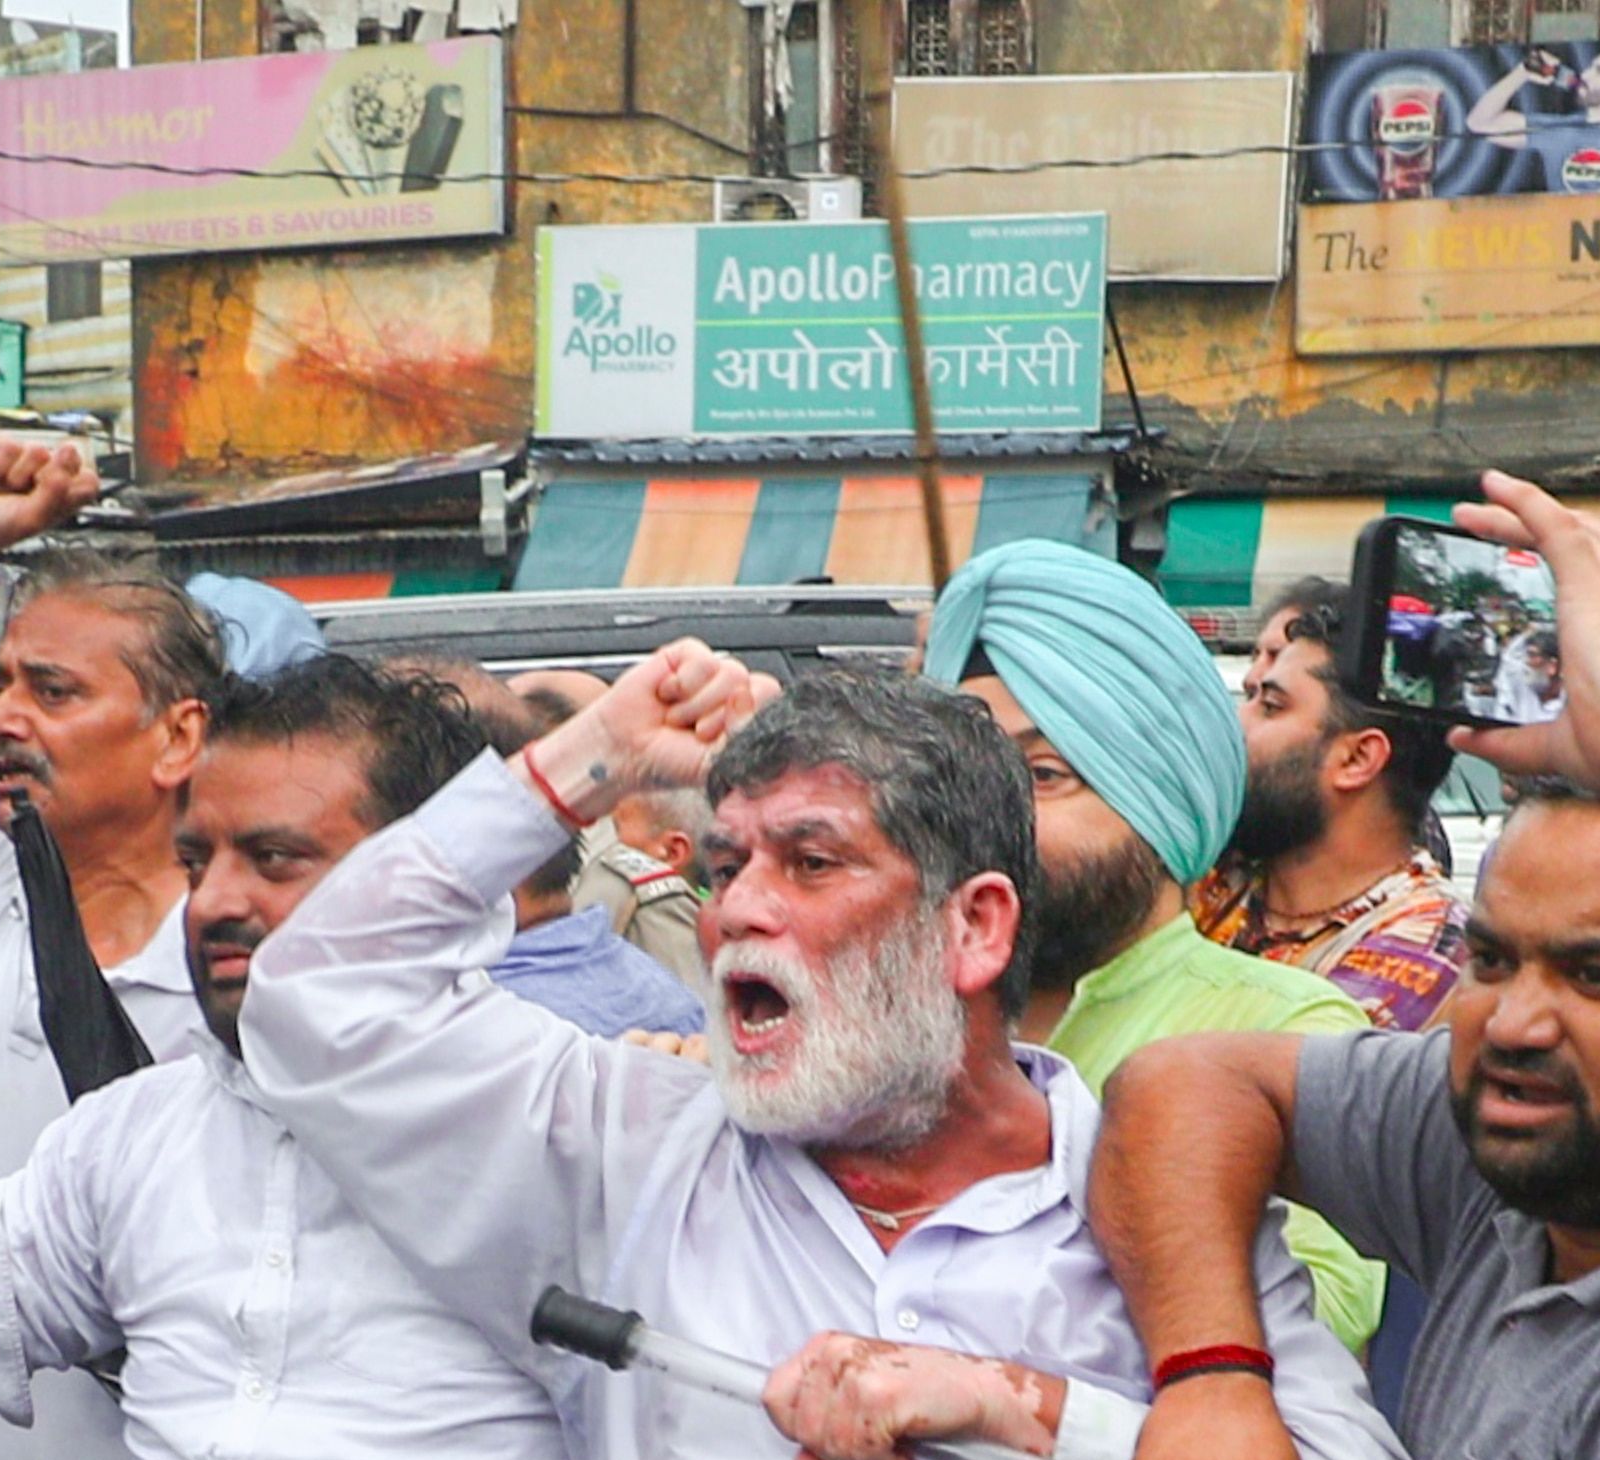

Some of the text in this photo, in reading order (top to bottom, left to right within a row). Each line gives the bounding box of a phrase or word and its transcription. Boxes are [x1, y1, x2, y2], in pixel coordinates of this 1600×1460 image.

[1383, 120, 1432, 134] PEPSI
[133, 216, 240, 245] SWEETS
[246, 213, 265, 235] &
[273, 203, 435, 235] SAVOURIES
[1314, 231, 1389, 273] The
[1404, 220, 1552, 269] NEWS
[563, 325, 677, 373] Apollo
[712, 327, 898, 391] अपोलो
